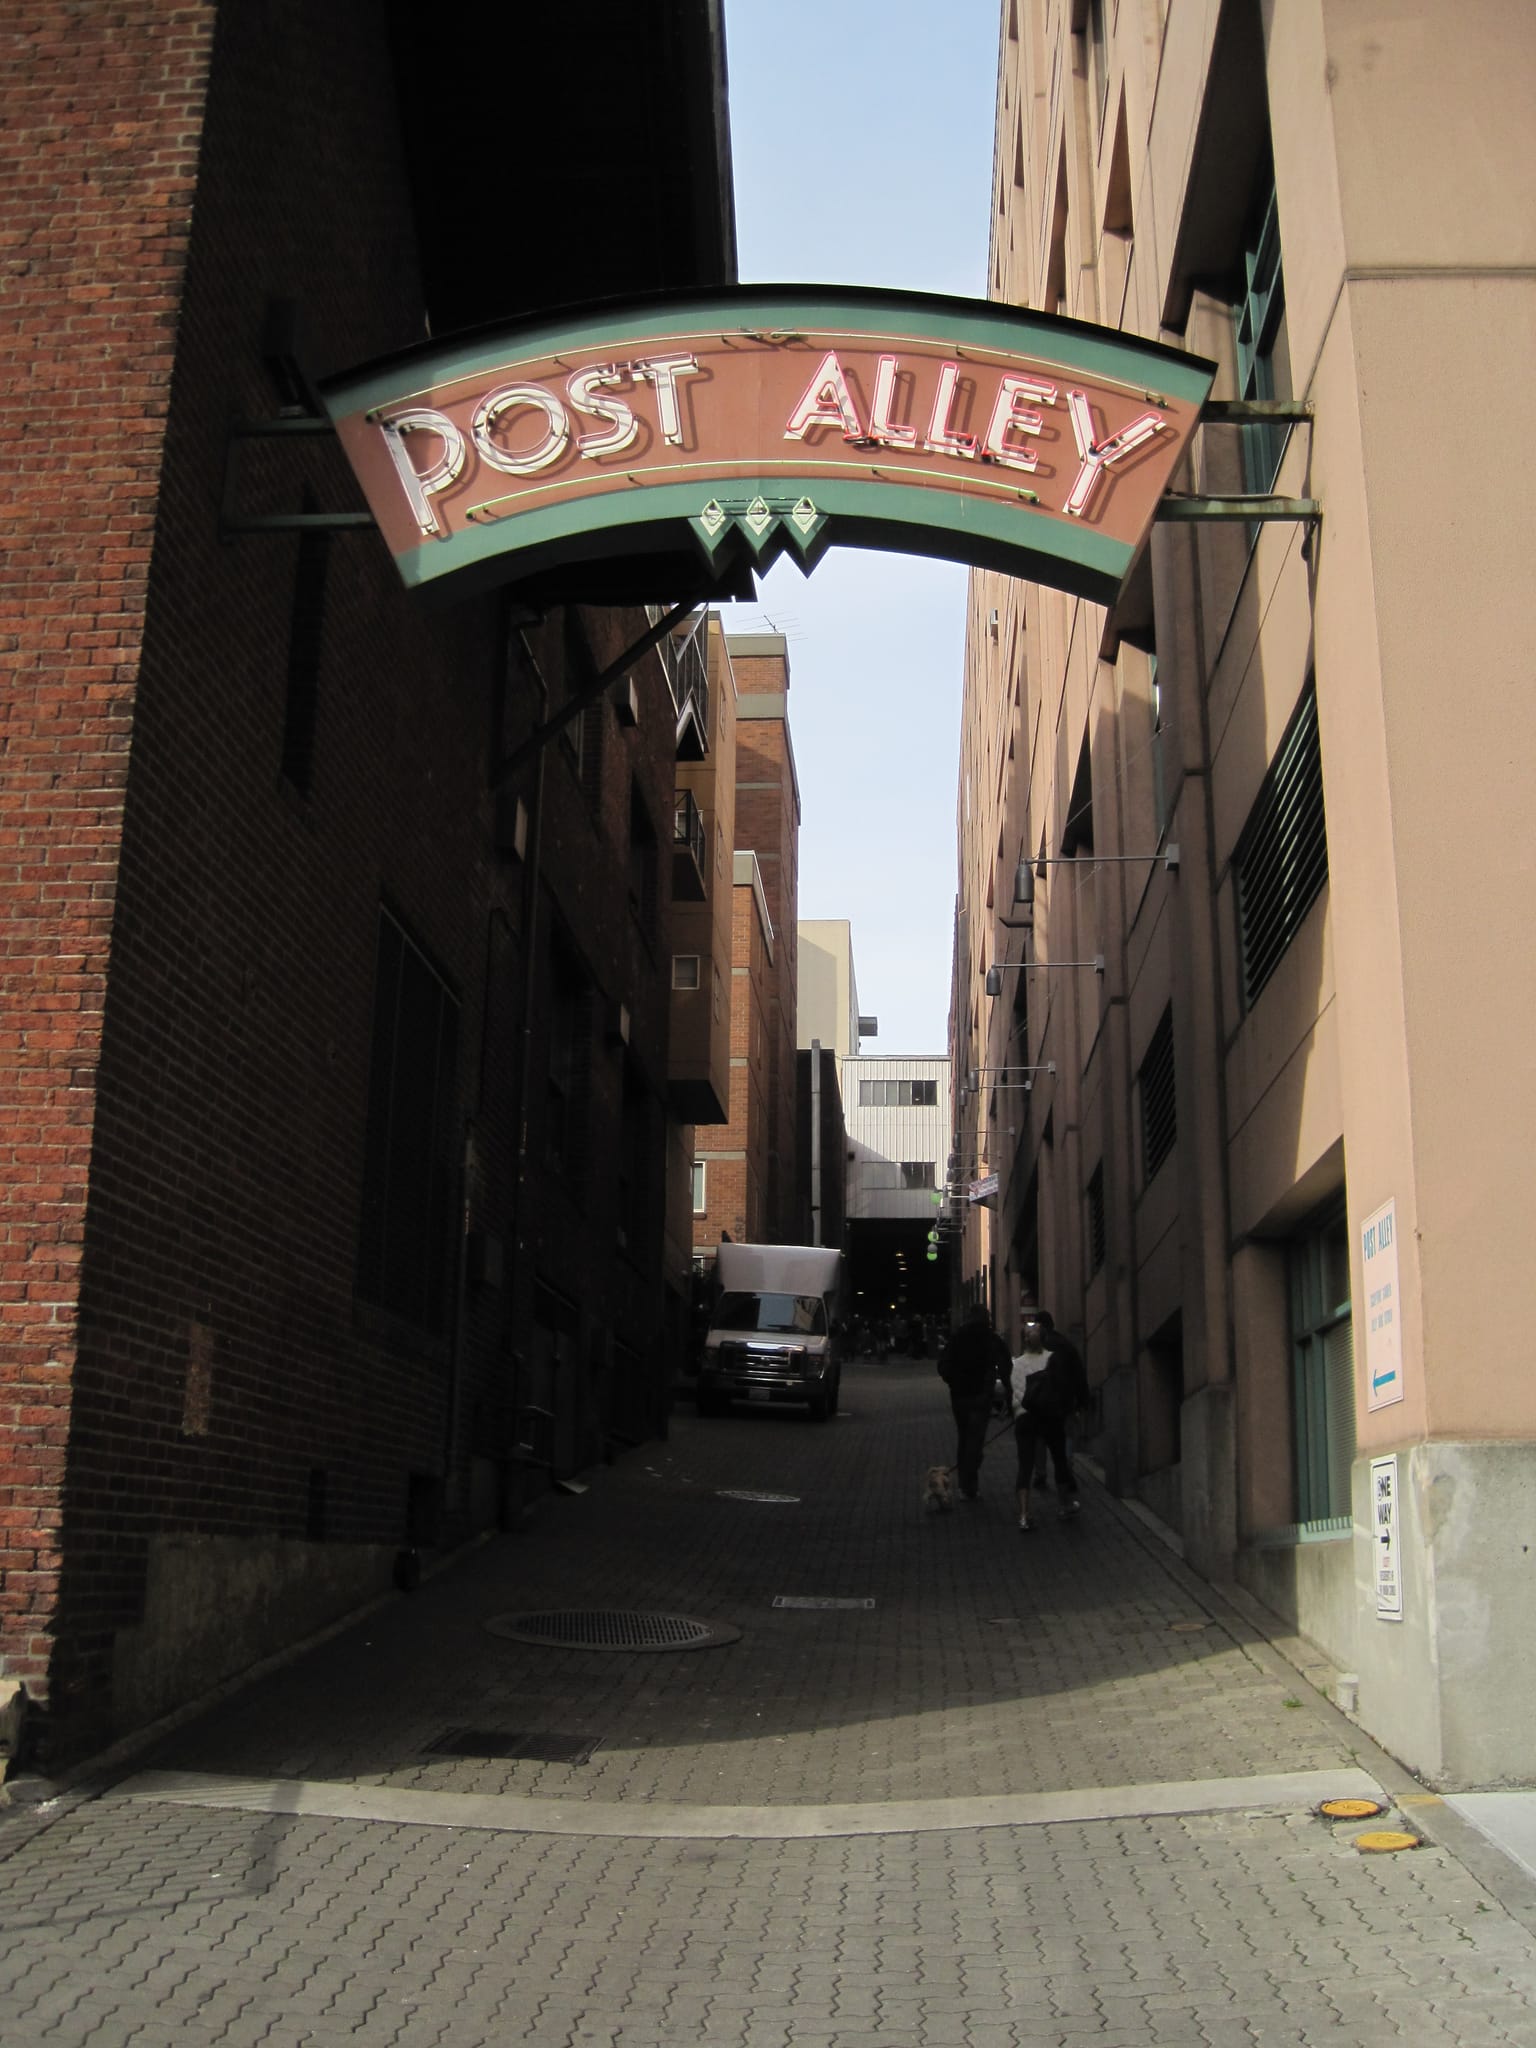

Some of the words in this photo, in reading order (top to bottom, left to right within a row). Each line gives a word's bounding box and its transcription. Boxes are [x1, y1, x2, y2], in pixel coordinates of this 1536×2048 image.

[383, 352, 698, 536] POST
[784, 350, 1163, 516] ALLEY
[1363, 1227, 1376, 1262] POST
[1378, 1213, 1393, 1250] ALLEY
[1377, 1503, 1392, 1525] WAY
